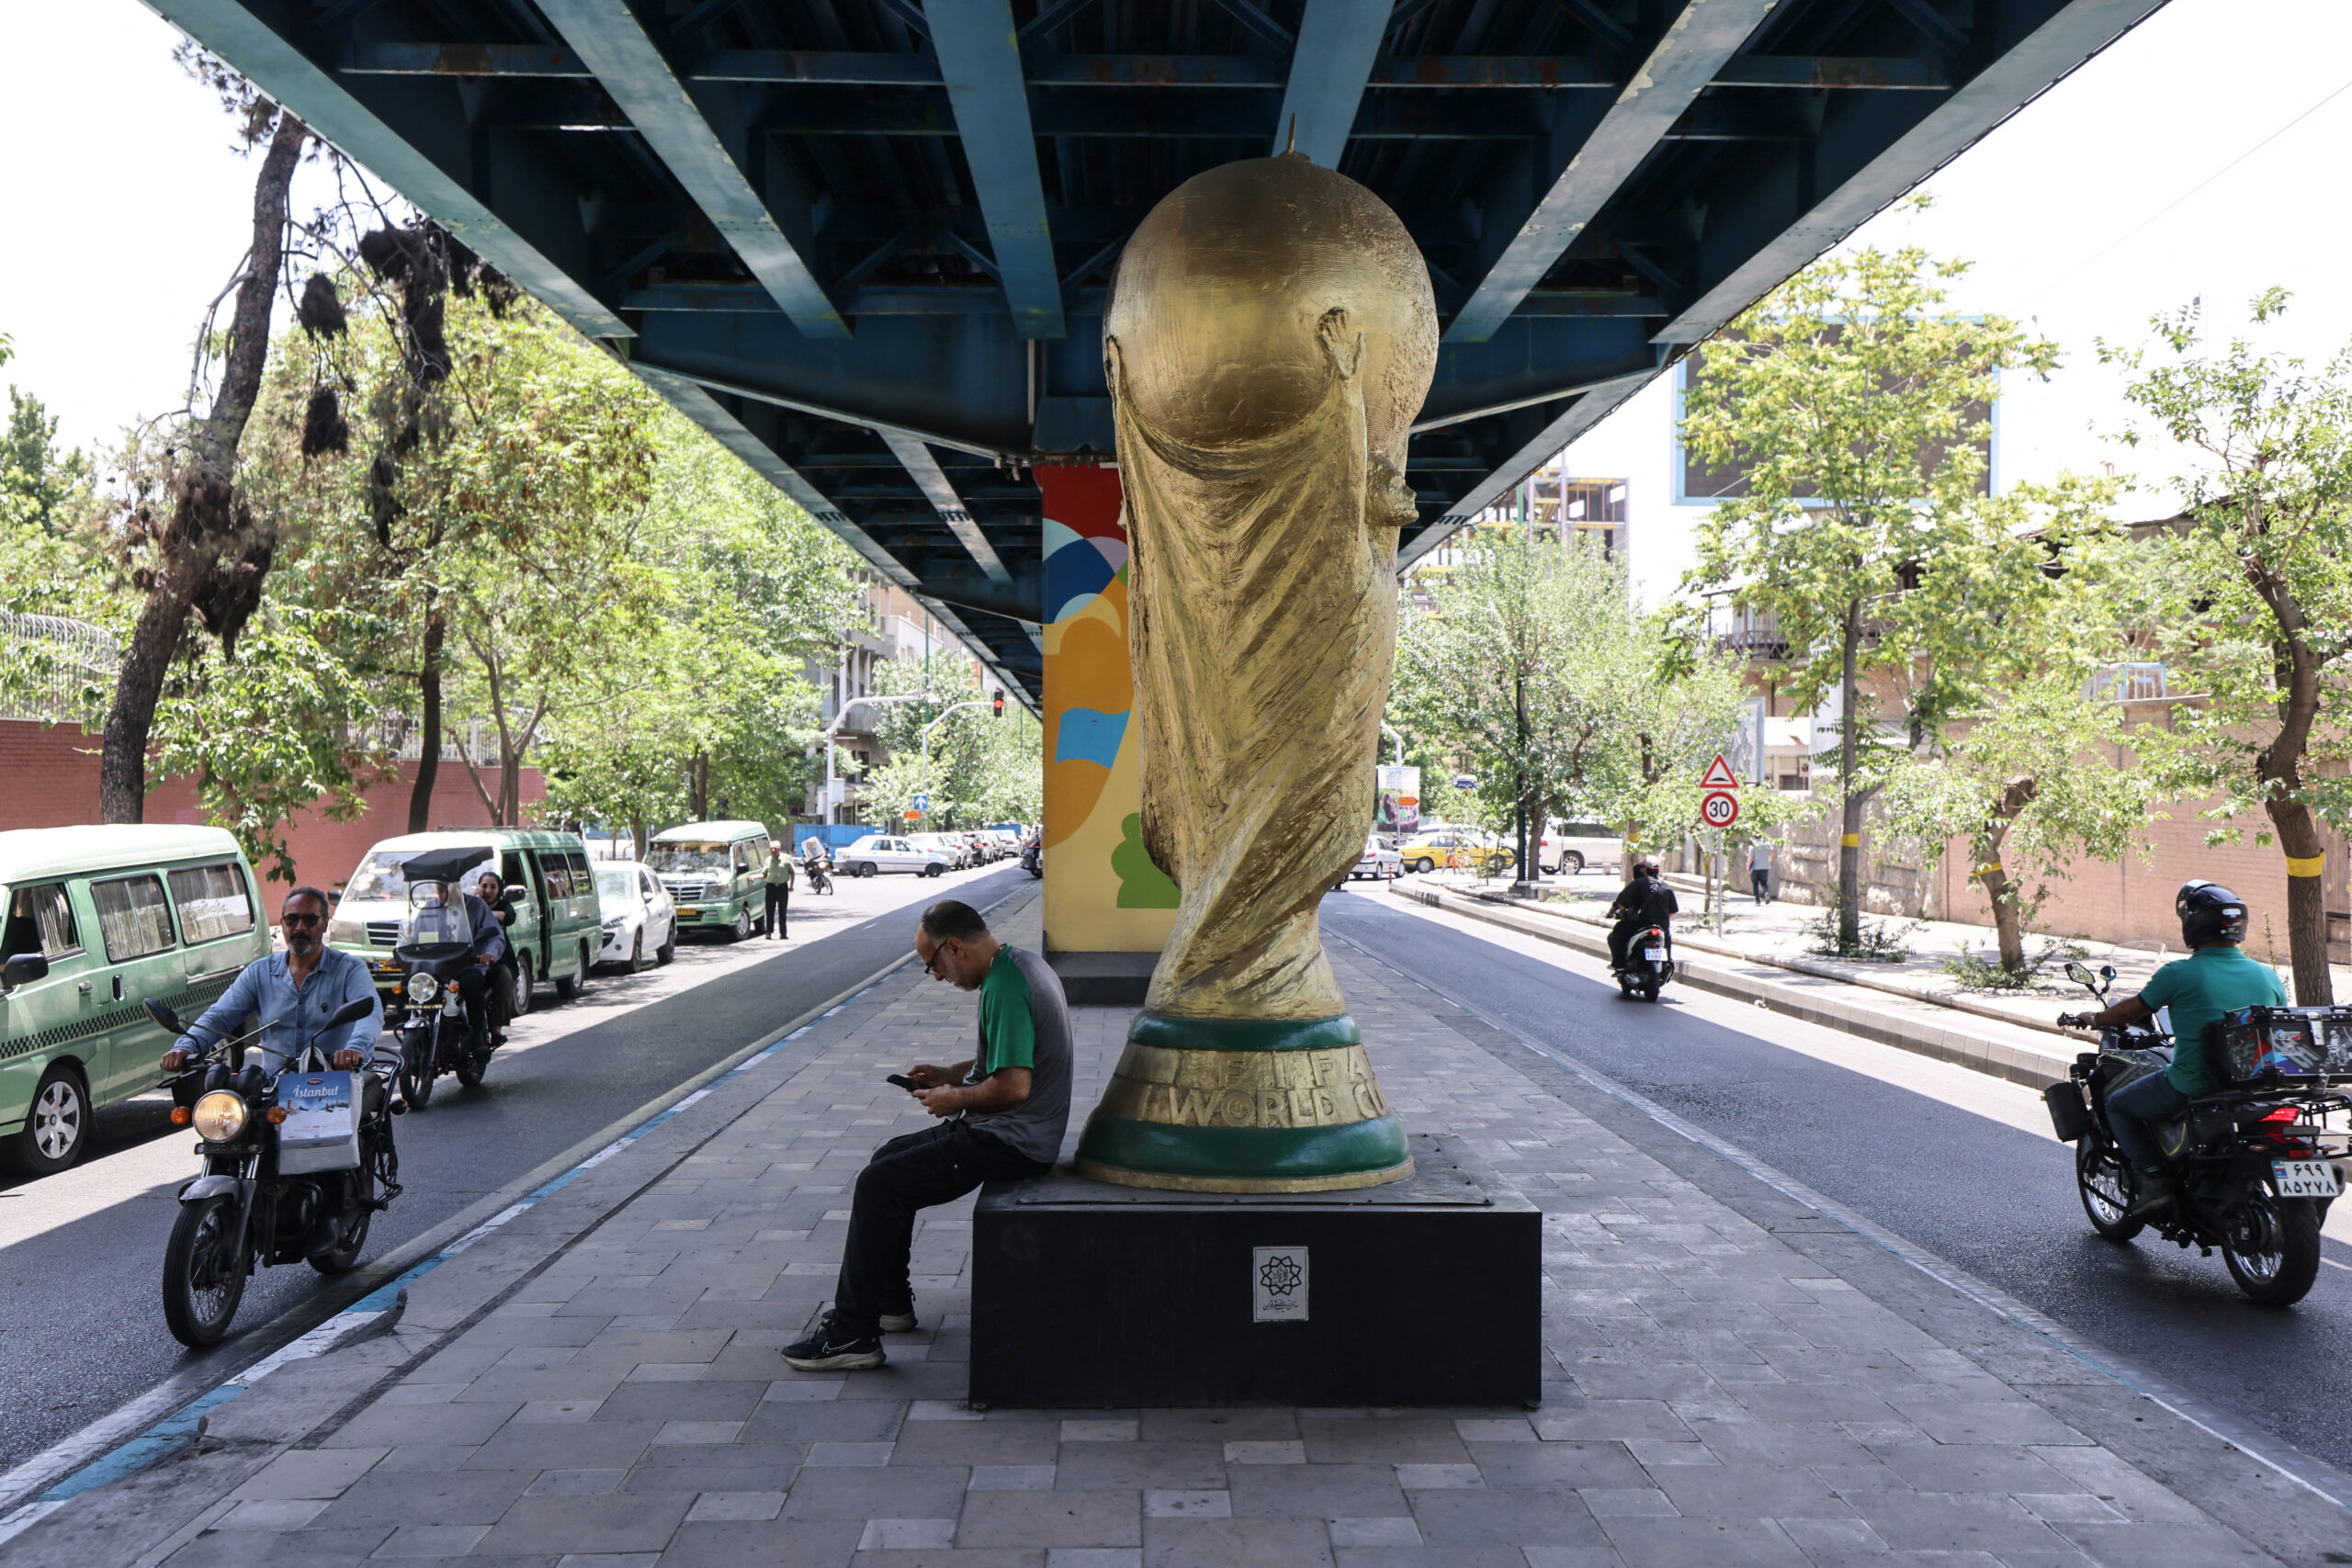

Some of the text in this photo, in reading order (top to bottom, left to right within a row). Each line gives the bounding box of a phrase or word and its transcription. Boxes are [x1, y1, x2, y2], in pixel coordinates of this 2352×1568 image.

[1709, 800, 1729, 818] 30
[1218, 1044, 1374, 1088] FIFA
[1169, 1084, 1335, 1128] WORLD
[2294, 1164, 2325, 1176] ۶۹۹
[2284, 1180, 2335, 1193] ۸۵۲۷۸
